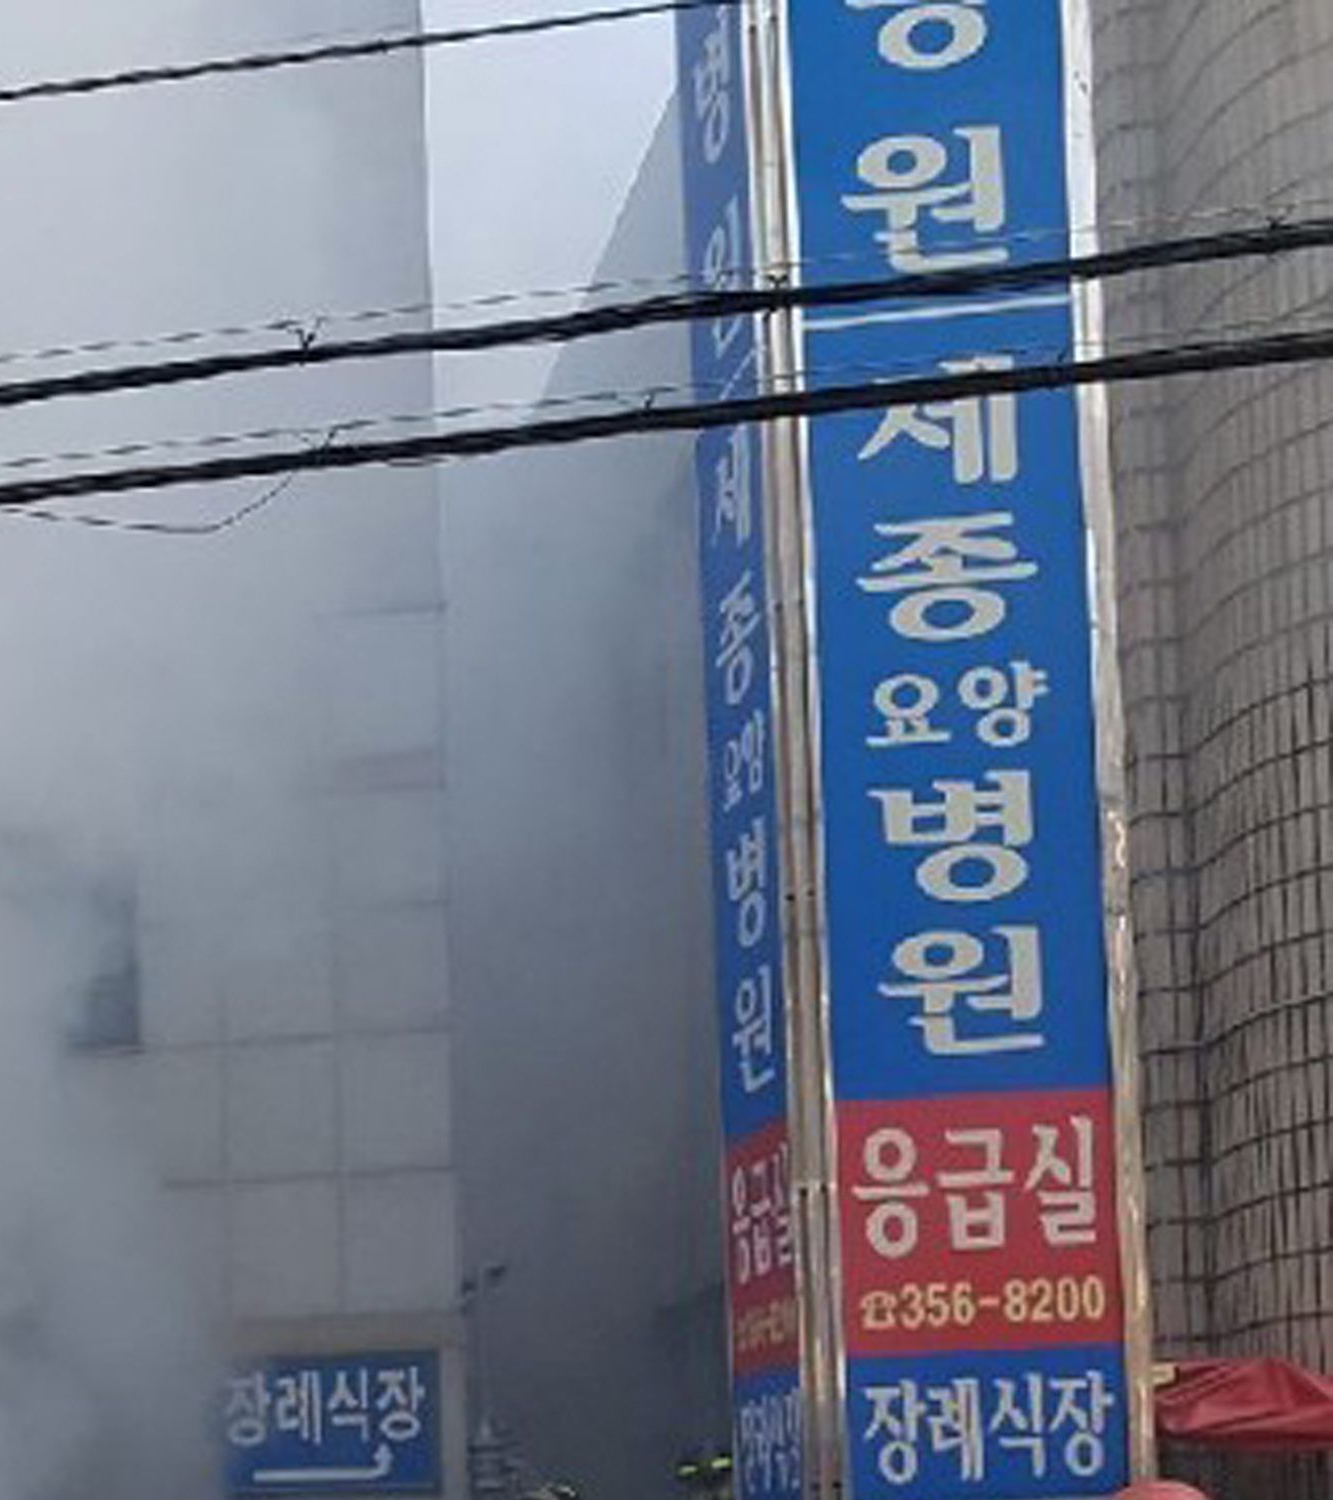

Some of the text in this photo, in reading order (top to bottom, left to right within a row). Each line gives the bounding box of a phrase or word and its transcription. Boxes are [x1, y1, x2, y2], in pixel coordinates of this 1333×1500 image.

[852, 1116, 1097, 1259] 응급실
[899, 1275, 1107, 1330] 356-8200
[226, 1366, 426, 1445] 장례식장
[864, 1371, 1115, 1485] 장례식장
